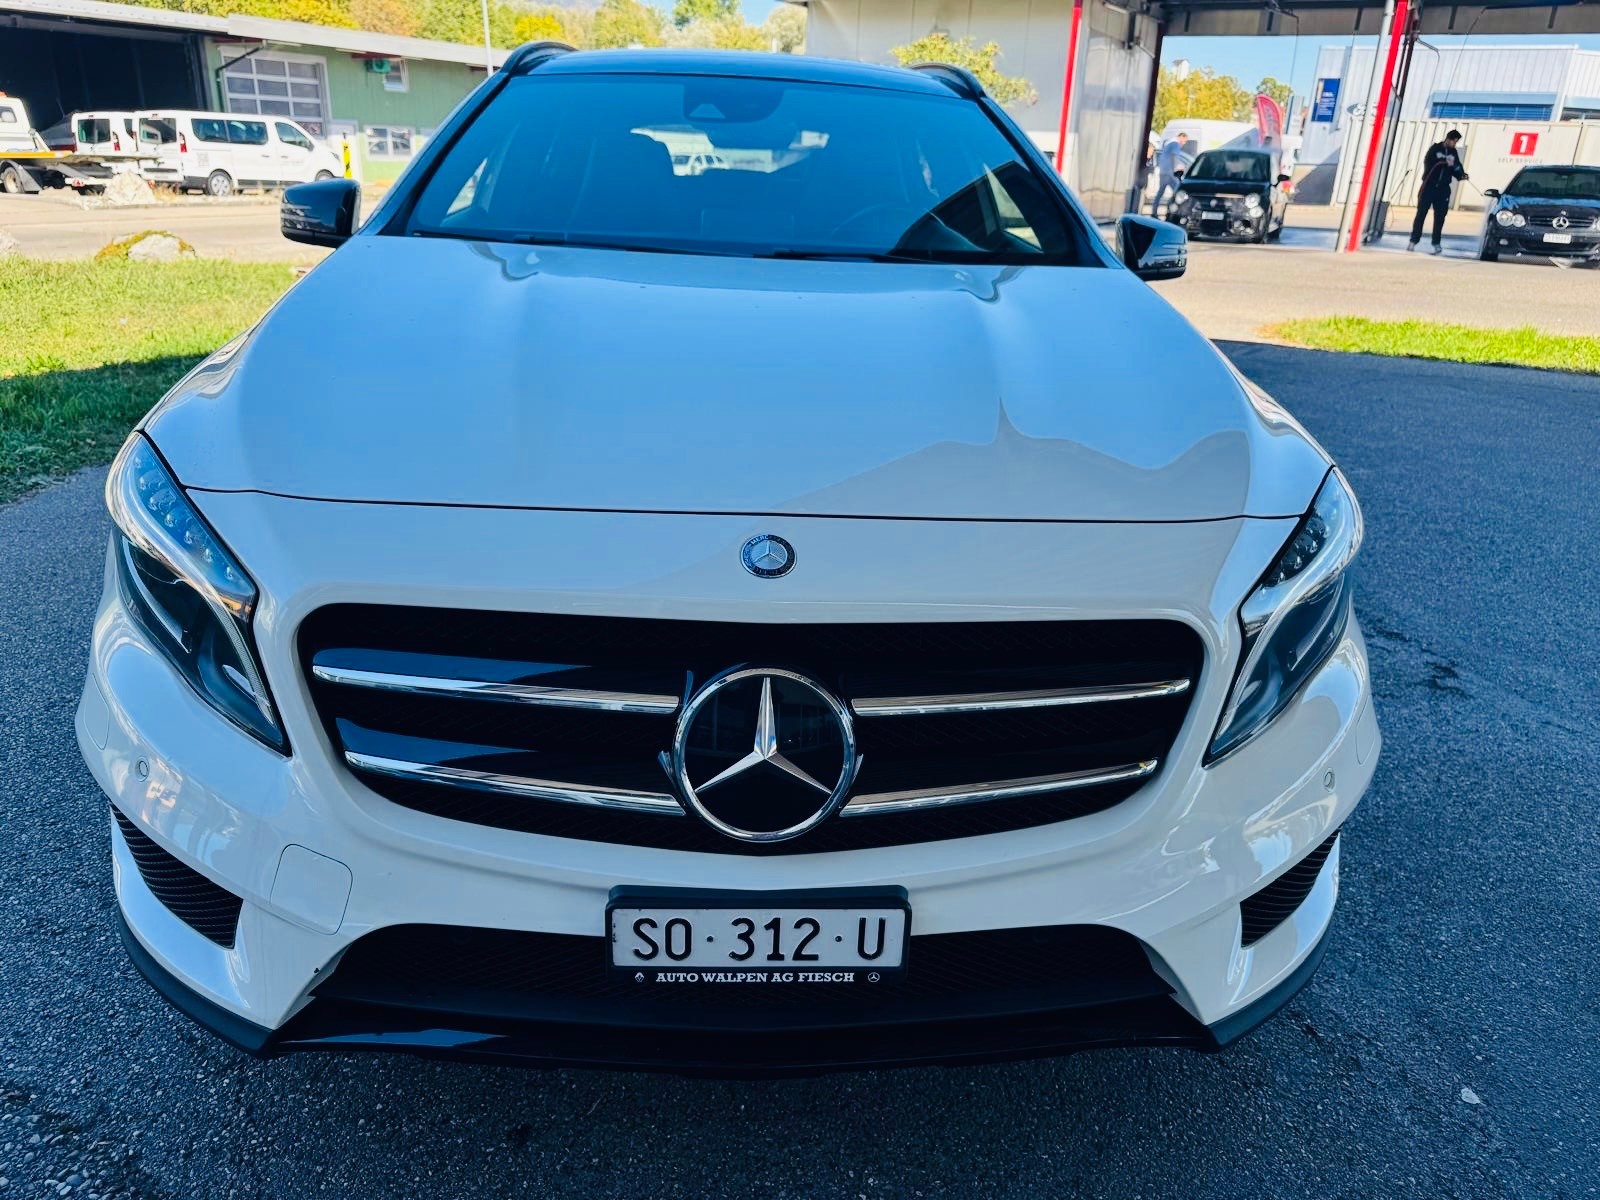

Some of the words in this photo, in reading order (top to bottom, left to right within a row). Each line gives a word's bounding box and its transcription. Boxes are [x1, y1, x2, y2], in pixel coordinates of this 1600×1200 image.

[1520, 135, 1529, 153] 1
[656, 972, 699, 983] AUTO
[701, 972, 768, 983] WALPEN
[771, 972, 794, 983] AG
[798, 972, 855, 983] FIESCH
